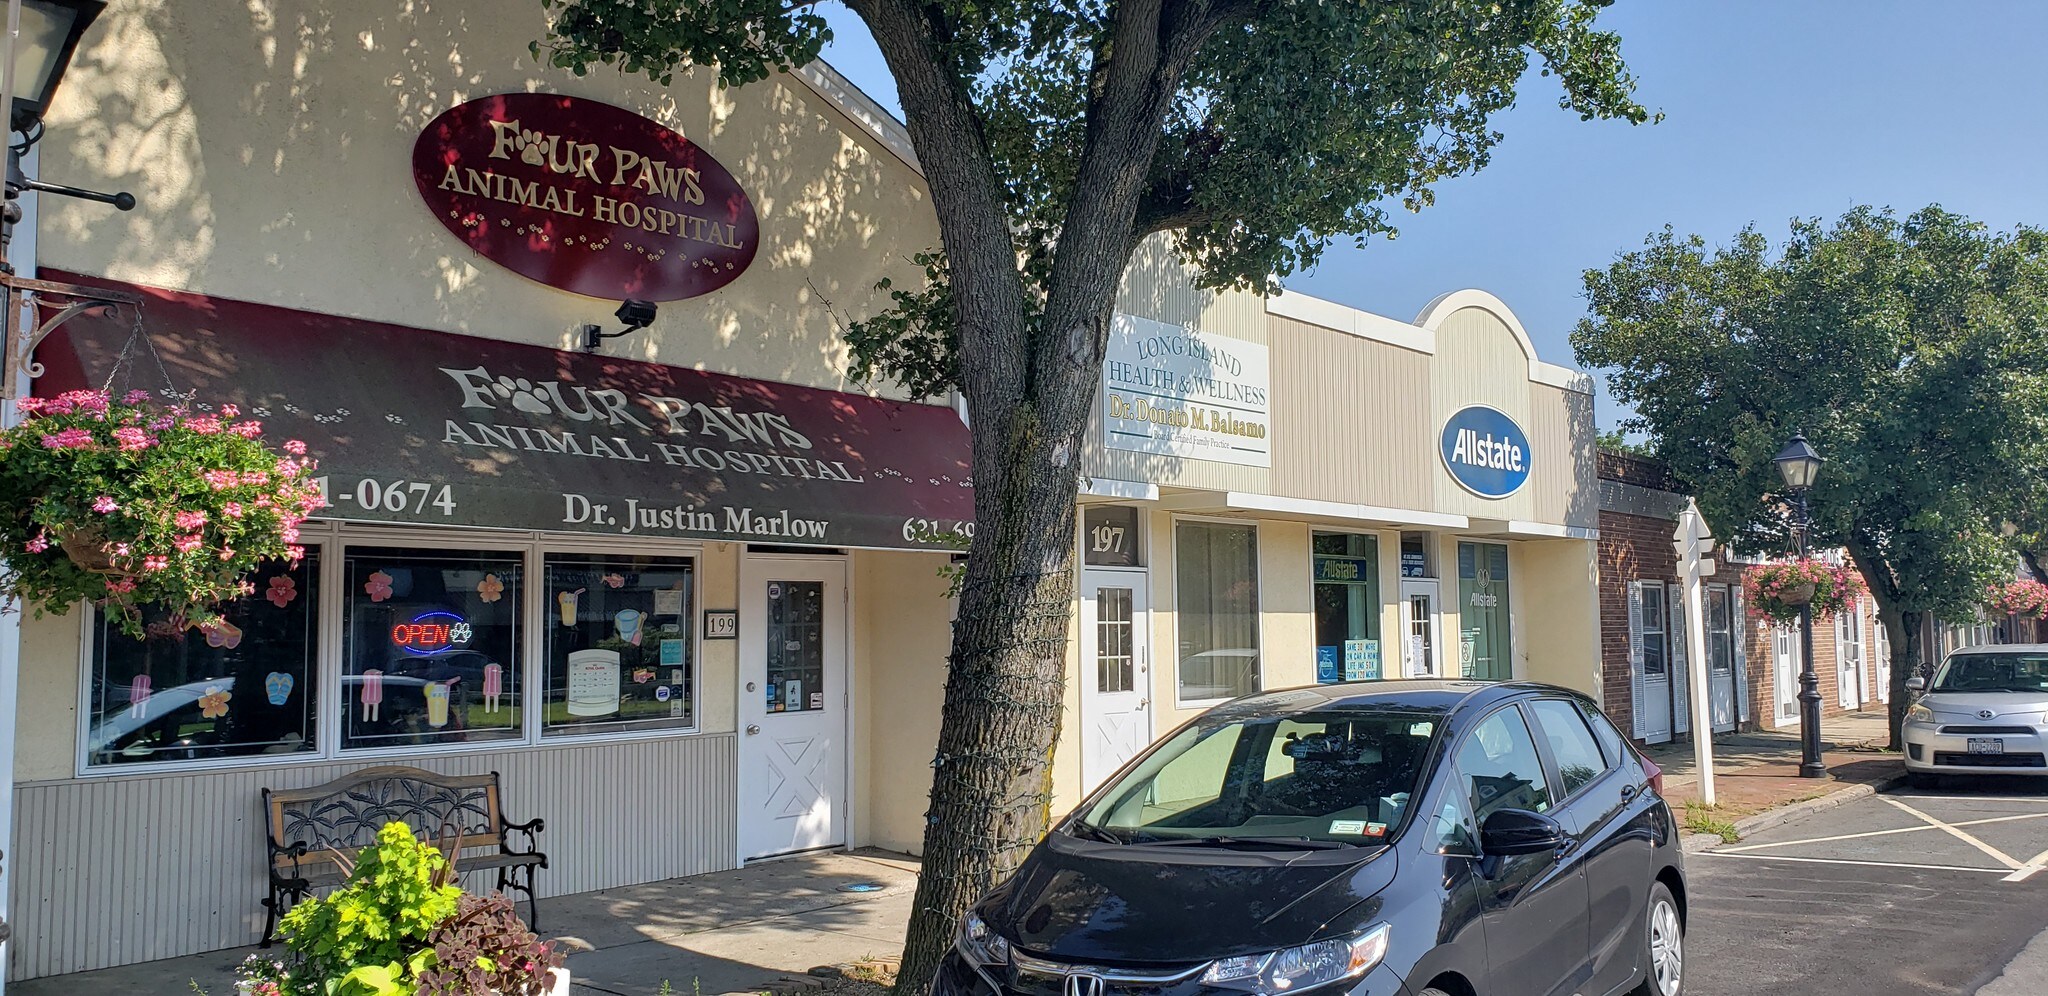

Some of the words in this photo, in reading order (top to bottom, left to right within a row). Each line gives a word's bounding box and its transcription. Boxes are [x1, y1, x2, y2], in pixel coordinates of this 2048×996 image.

[609, 146, 705, 206] PAWS
[438, 164, 584, 218] ANIMAL
[593, 196, 744, 250] HOSPITAL
[1136, 335, 1183, 361] LONG
[1187, 335, 1242, 377] ISLAND
[1109, 360, 1175, 390] HEALTH
[1178, 375, 1191, 394] &
[1193, 376, 1266, 406] WELLNESS
[639, 392, 813, 450] PAWS
[1109, 394, 1134, 421] Dr.
[1136, 398, 1189, 428] Donato
[1190, 407, 1209, 431] M.
[1210, 410, 1266, 440] Balsamo
[441, 419, 651, 463] ANIMAL
[652, 442, 865, 484] HOSPITAL
[1210, 438, 1230, 449] Practice
[1451, 428, 1522, 472] Allstate
[562, 493, 616, 526] Dr.
[622, 498, 717, 533] Justin
[723, 506, 829, 539] Marlow
[1091, 525, 1125, 553] 197
[1322, 560, 1358, 579] Allstate
[1470, 592, 1497, 607] Allstate
[393, 623, 450, 645] OPEN
[710, 617, 734, 633] 199
